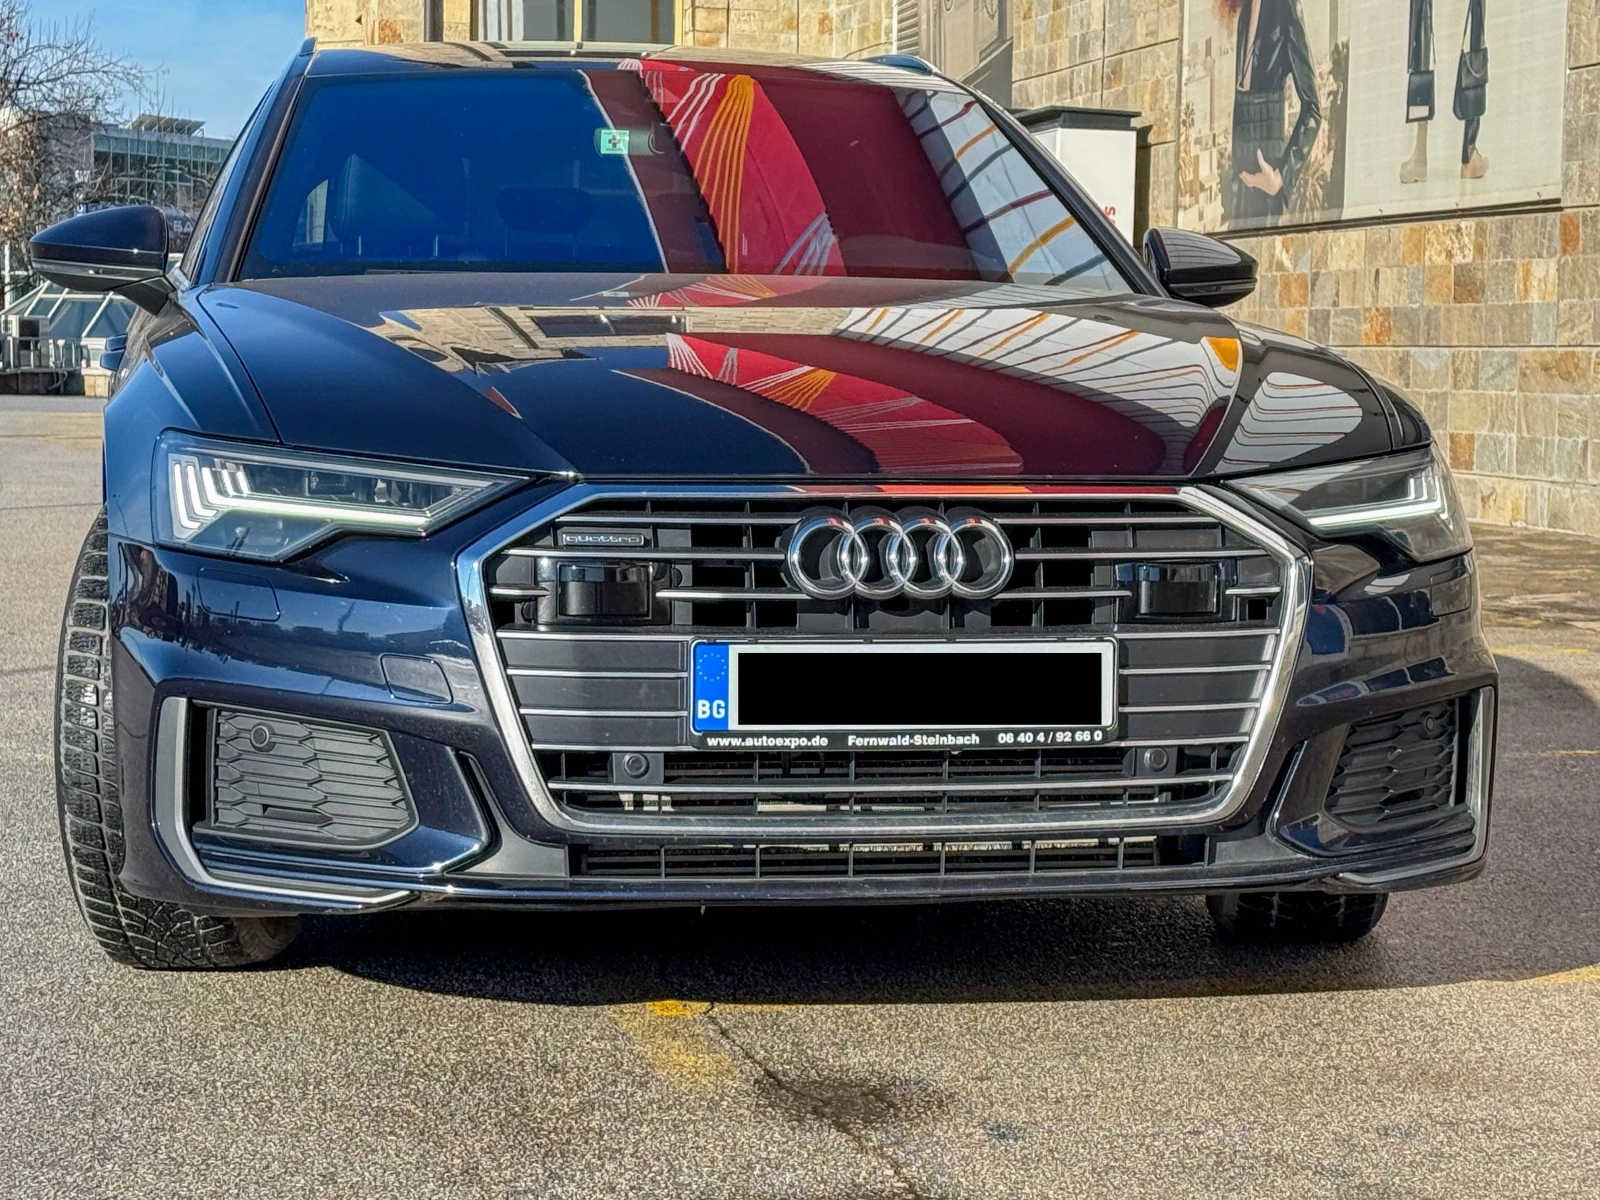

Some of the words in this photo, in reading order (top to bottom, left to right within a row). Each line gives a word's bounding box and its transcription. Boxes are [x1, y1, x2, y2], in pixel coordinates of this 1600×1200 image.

[565, 535, 640, 544] quattro
[697, 699, 726, 719] BG
[706, 735, 829, 749] www.autoexpo.de
[847, 733, 981, 746] Fernwald-Steinbach
[998, 733, 1014, 743] 06
[1017, 732, 1034, 743] 40
[1036, 732, 1046, 743] 4
[1055, 731, 1073, 742] 92
[1075, 731, 1092, 742] 66
[1093, 730, 1103, 741] 0
